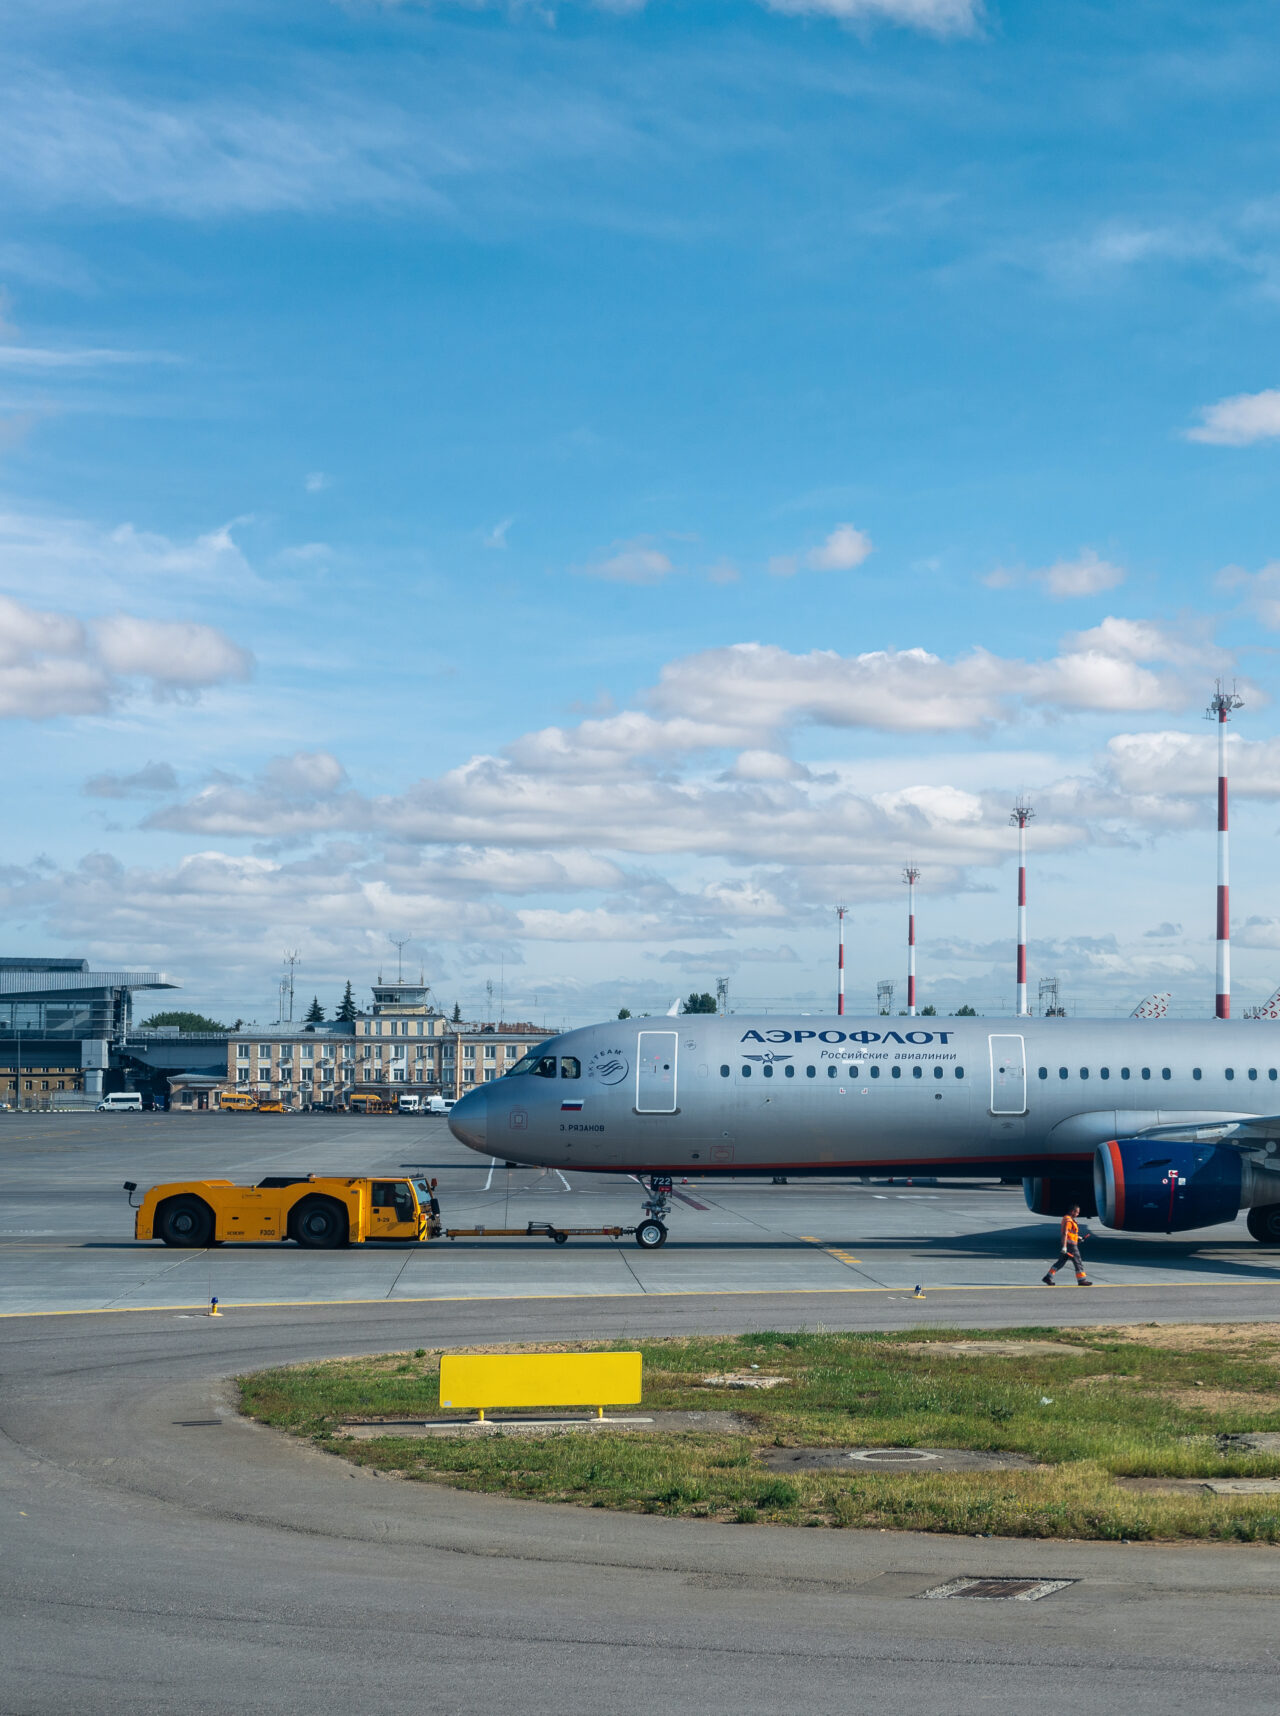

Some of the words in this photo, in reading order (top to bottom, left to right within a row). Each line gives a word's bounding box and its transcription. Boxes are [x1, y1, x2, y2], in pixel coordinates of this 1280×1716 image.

[740, 1029, 955, 1045] АЭРОФЛОТ
[820, 1050, 889, 1060] Российские
[894, 1053, 957, 1061] авиалинии
[568, 1124, 605, 1132] РЯЗАНОВ
[653, 1177, 671, 1185] 722
